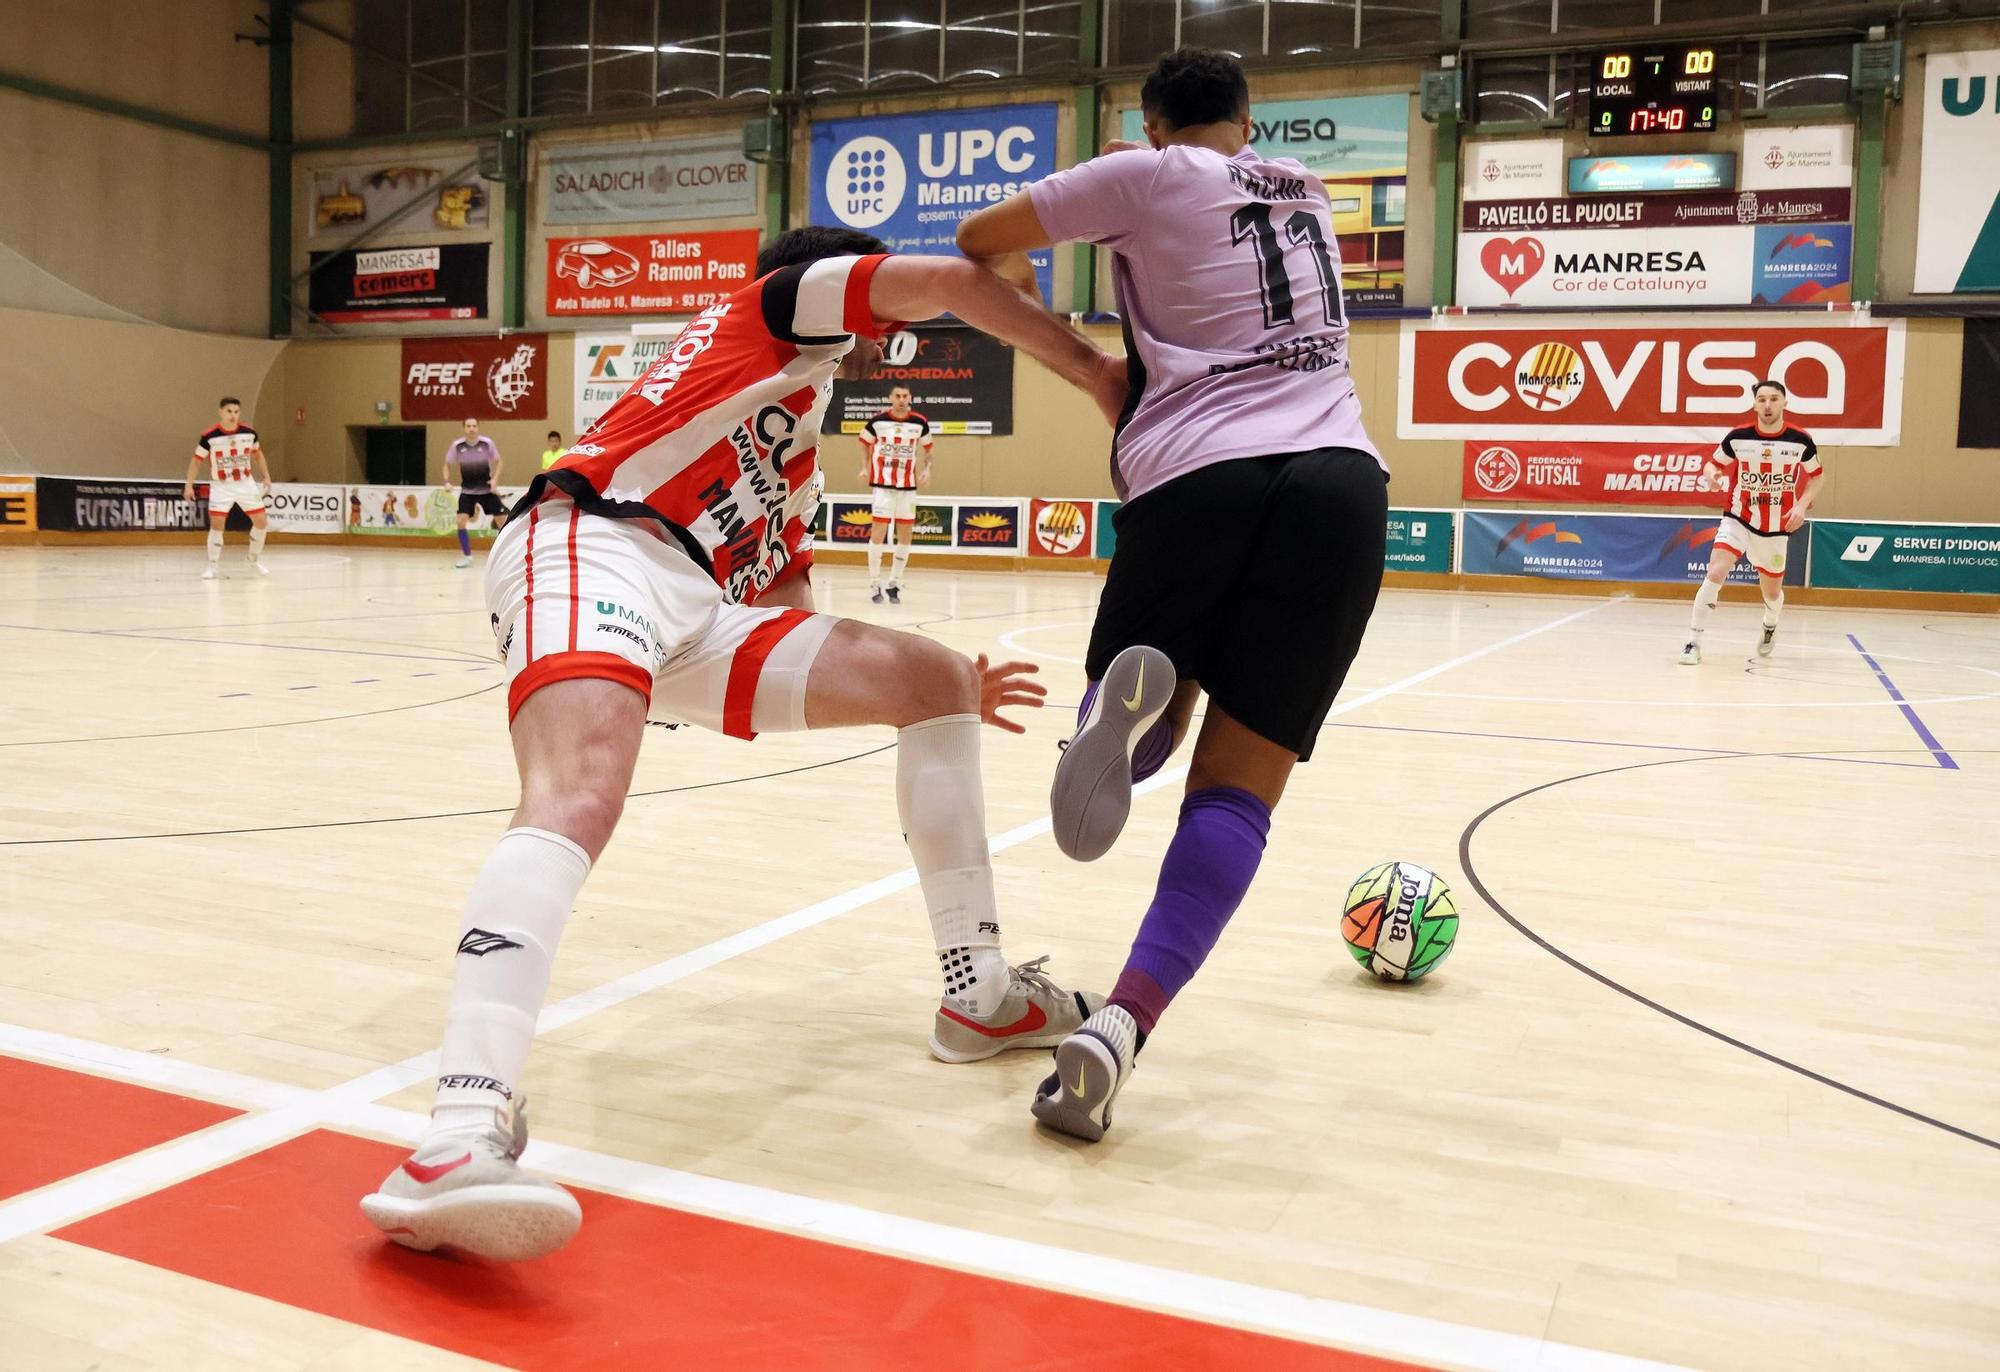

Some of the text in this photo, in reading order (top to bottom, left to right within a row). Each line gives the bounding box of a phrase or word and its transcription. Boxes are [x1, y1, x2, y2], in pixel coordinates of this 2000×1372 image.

[1603, 56, 1631, 79] 00
[1685, 51, 1714, 74] 00
[1597, 80, 1711, 96] LOCAL VISITANT
[1942, 76, 2000, 116] U
[1602, 107, 1712, 131] 0 17:40 0
[918, 125, 1036, 178] UPC
[1788, 150, 1832, 160] Ajuntament
[1798, 159, 1831, 167] Manresa
[555, 163, 748, 194] SALADICH CLOVER
[847, 198, 883, 215] UPC
[1479, 202, 1644, 226] PAVELLÓ EL PUJOLET
[1675, 201, 1822, 219] Ajuntament de Manresa
[650, 240, 701, 259] Tallers
[649, 259, 746, 282] Ramon Pons
[1230, 202, 1345, 330] 11
[1500, 253, 1525, 275] M
[1554, 251, 1706, 274] MANRESA
[1764, 263, 1837, 272] MANRESA2024
[1553, 276, 1707, 293] Cor de Catalunya
[407, 362, 474, 385] RFEF
[1518, 372, 1582, 389] Manresa F.S.
[414, 384, 465, 396] FUTSAL
[1527, 456, 1582, 465] FEDERACIÓN
[1633, 454, 1702, 472] CLUB
[1526, 465, 1581, 486] FUTSAL
[962, 527, 1012, 543] ESCLAT
[1893, 537, 1942, 549] SERVEI
[1523, 556, 1603, 567] MANRESA2024
[1893, 554, 1945, 565] UMANRESA
